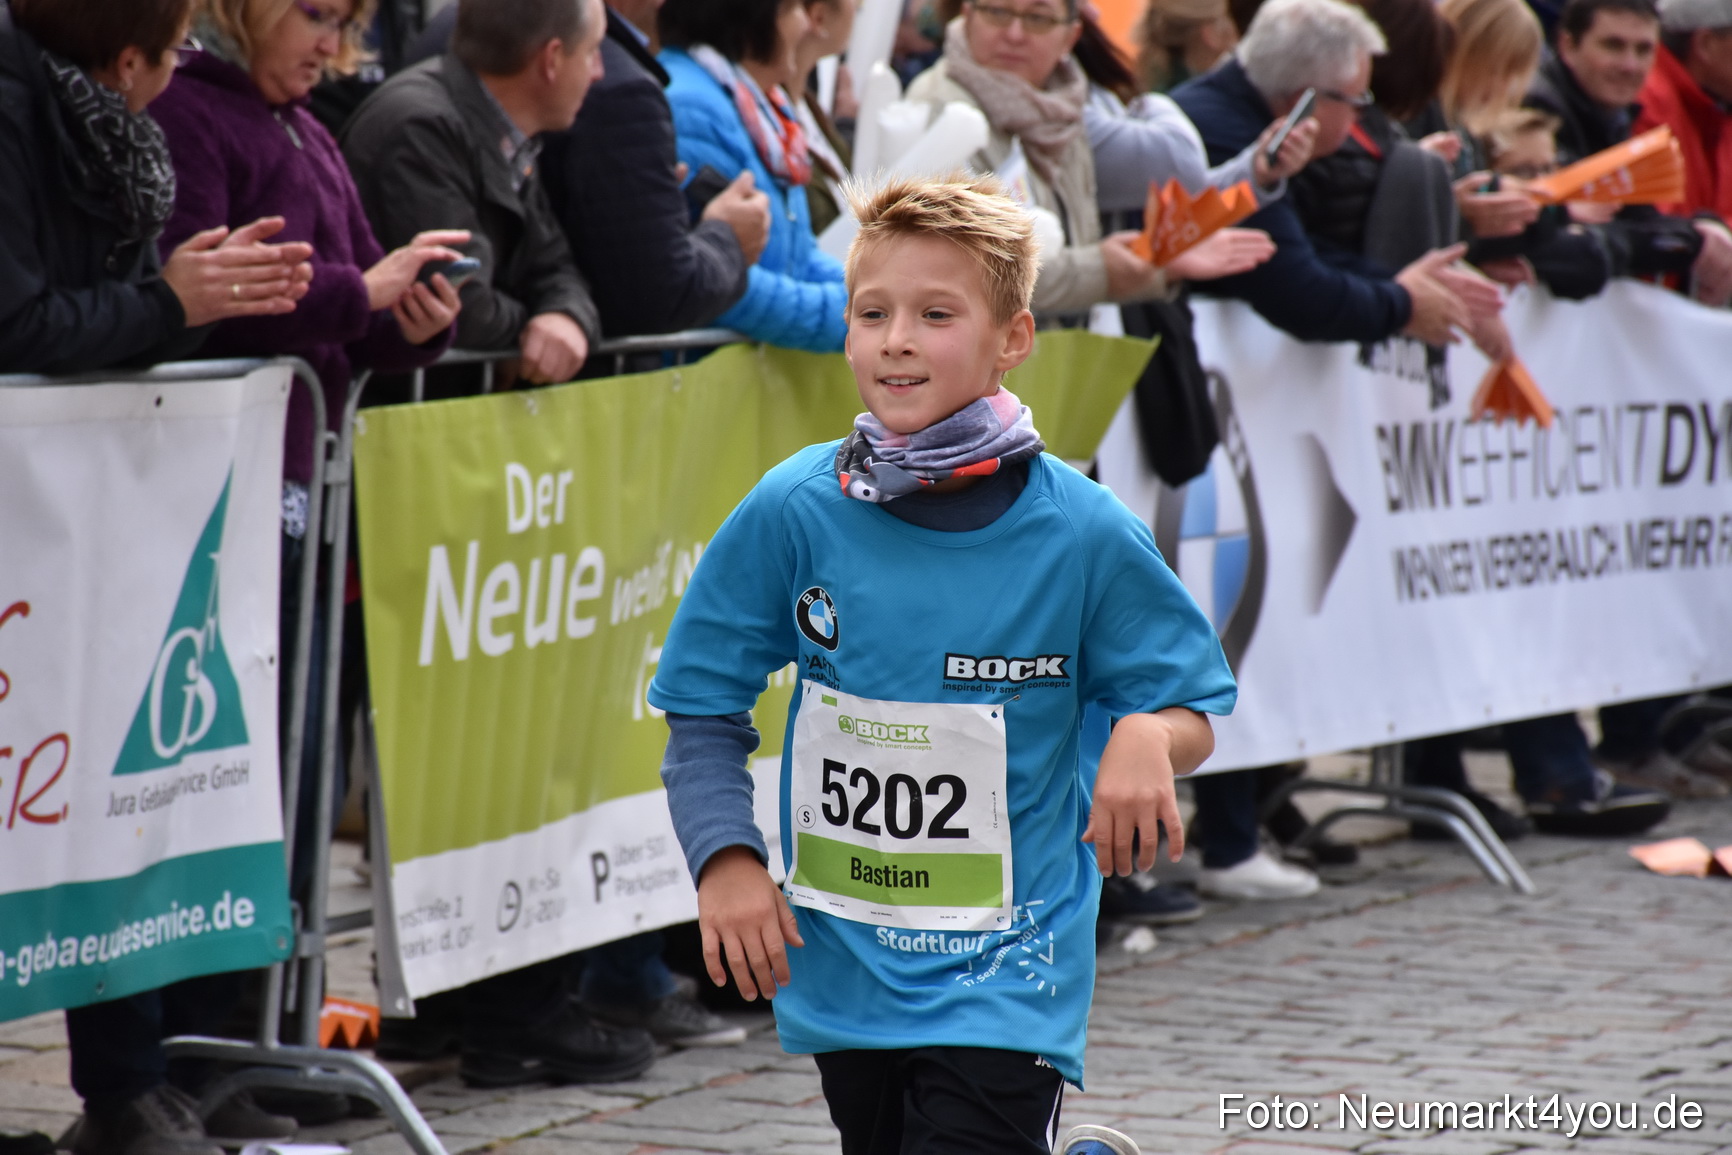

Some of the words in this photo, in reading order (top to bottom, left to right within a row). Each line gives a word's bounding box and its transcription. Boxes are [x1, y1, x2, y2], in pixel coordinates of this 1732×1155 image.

[505, 462, 574, 534] Der
[418, 540, 605, 666] Neue
[944, 653, 1071, 684] BOCK
[942, 682, 983, 693] inspired
[985, 683, 997, 694] by
[999, 683, 1025, 694] smart
[1027, 680, 1071, 689] concepts
[856, 718, 931, 744] BOCK
[904, 744, 933, 752] concepts
[106, 790, 137, 818] Jura
[821, 758, 969, 840] 5202
[850, 856, 930, 889] Bastian
[876, 926, 992, 955] Stadtlauf
[977, 941, 1020, 982] September
